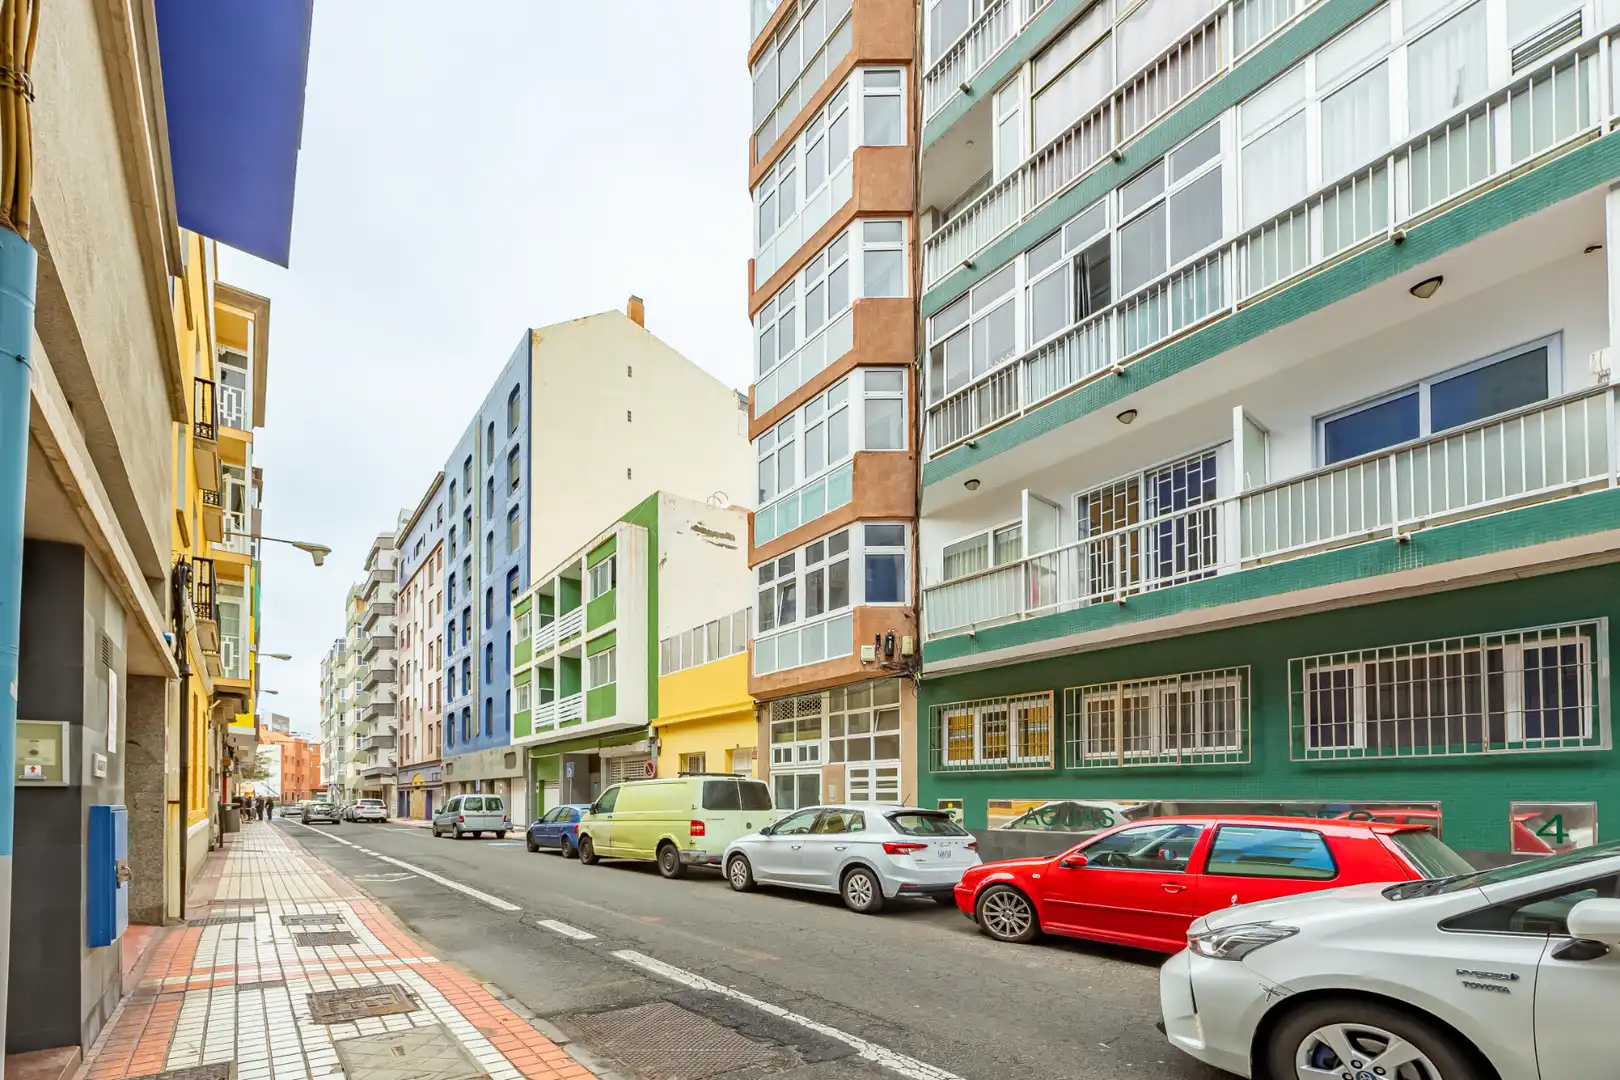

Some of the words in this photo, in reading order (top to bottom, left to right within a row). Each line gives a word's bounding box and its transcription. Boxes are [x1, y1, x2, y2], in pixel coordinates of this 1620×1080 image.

[1023, 807, 1115, 828] AGUAS
[1536, 814, 1569, 844] 4
[1462, 980, 1511, 994] TOYOTA
